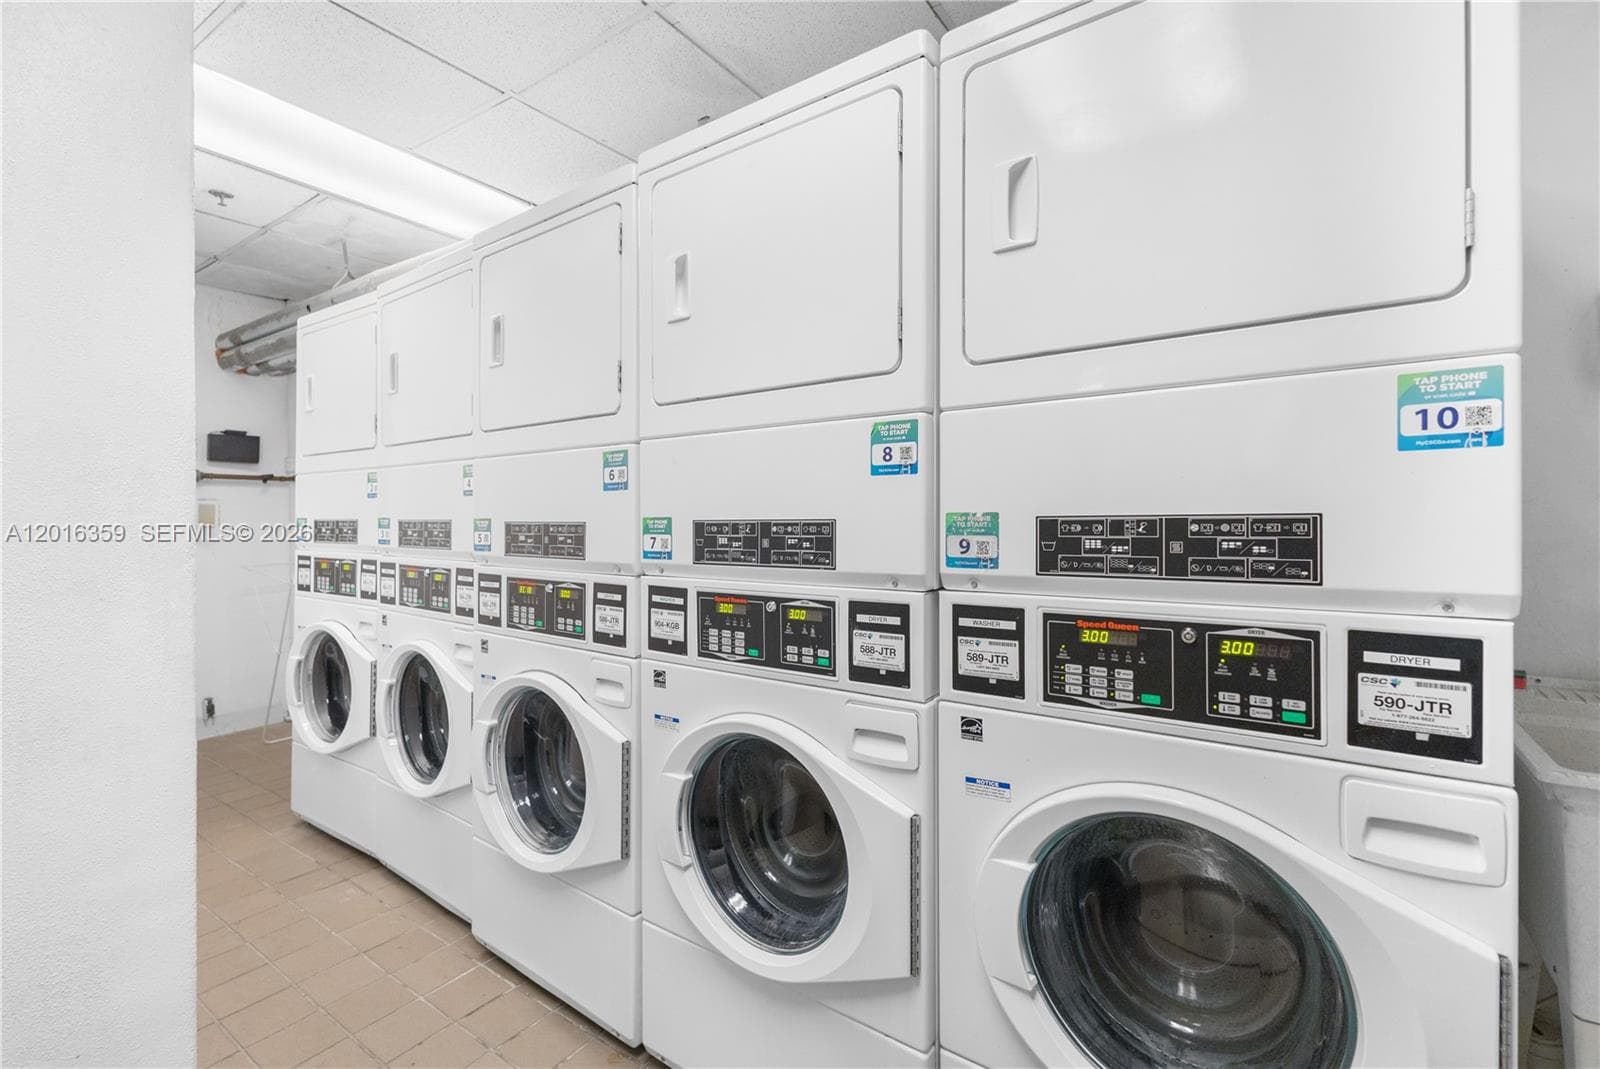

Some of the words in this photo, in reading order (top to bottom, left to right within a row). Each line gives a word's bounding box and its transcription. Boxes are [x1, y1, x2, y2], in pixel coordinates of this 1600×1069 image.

[1413, 375, 1438, 385] TAP
[1440, 371, 1488, 382] PHONE
[1418, 384, 1437, 393] TO
[1439, 380, 1482, 391] START
[1415, 406, 1459, 430] 10
[882, 446, 893, 463] 8
[608, 469, 615, 481] 6
[477, 533, 483, 543] 5
[650, 536, 657, 549] 7
[959, 538, 971, 554] 9
[788, 608, 807, 621] 3.00
[972, 620, 1001, 628] WASHER
[1076, 620, 1107, 629] Speed
[1107, 622, 1140, 630] Queen
[1081, 629, 1109, 643] 3.00
[859, 644, 897, 657] 588-JTR
[1220, 640, 1255, 656] 3.00
[966, 652, 1009, 665] 589-JTR
[1389, 655, 1432, 667] DRYER
[1360, 675, 1389, 685] CSC
[1373, 695, 1453, 716] 590-JTR
